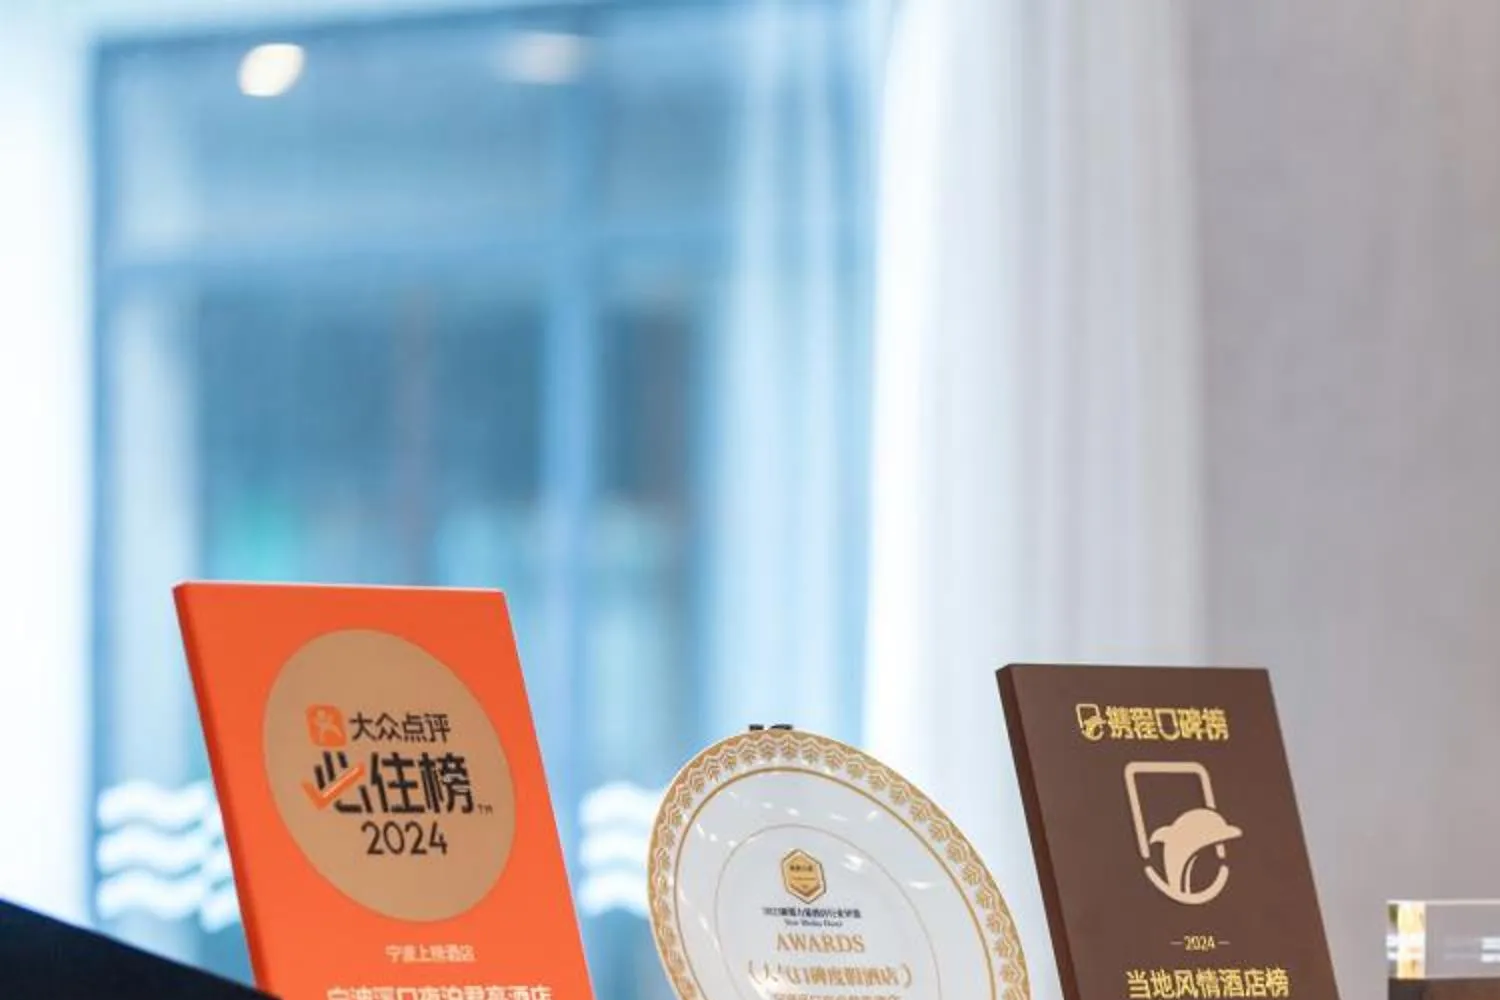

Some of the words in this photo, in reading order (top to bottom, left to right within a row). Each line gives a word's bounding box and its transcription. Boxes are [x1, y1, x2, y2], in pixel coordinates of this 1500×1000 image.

[349, 711, 451, 743] 大众点评
[1106, 705, 1229, 741] 携程口碑榜
[303, 751, 475, 814] 必住榜
[360, 820, 448, 855] 2024
[776, 932, 866, 954] AWARDS
[1183, 935, 1216, 952] 2024
[1126, 967, 1290, 1000] 当地风情酒店榜
